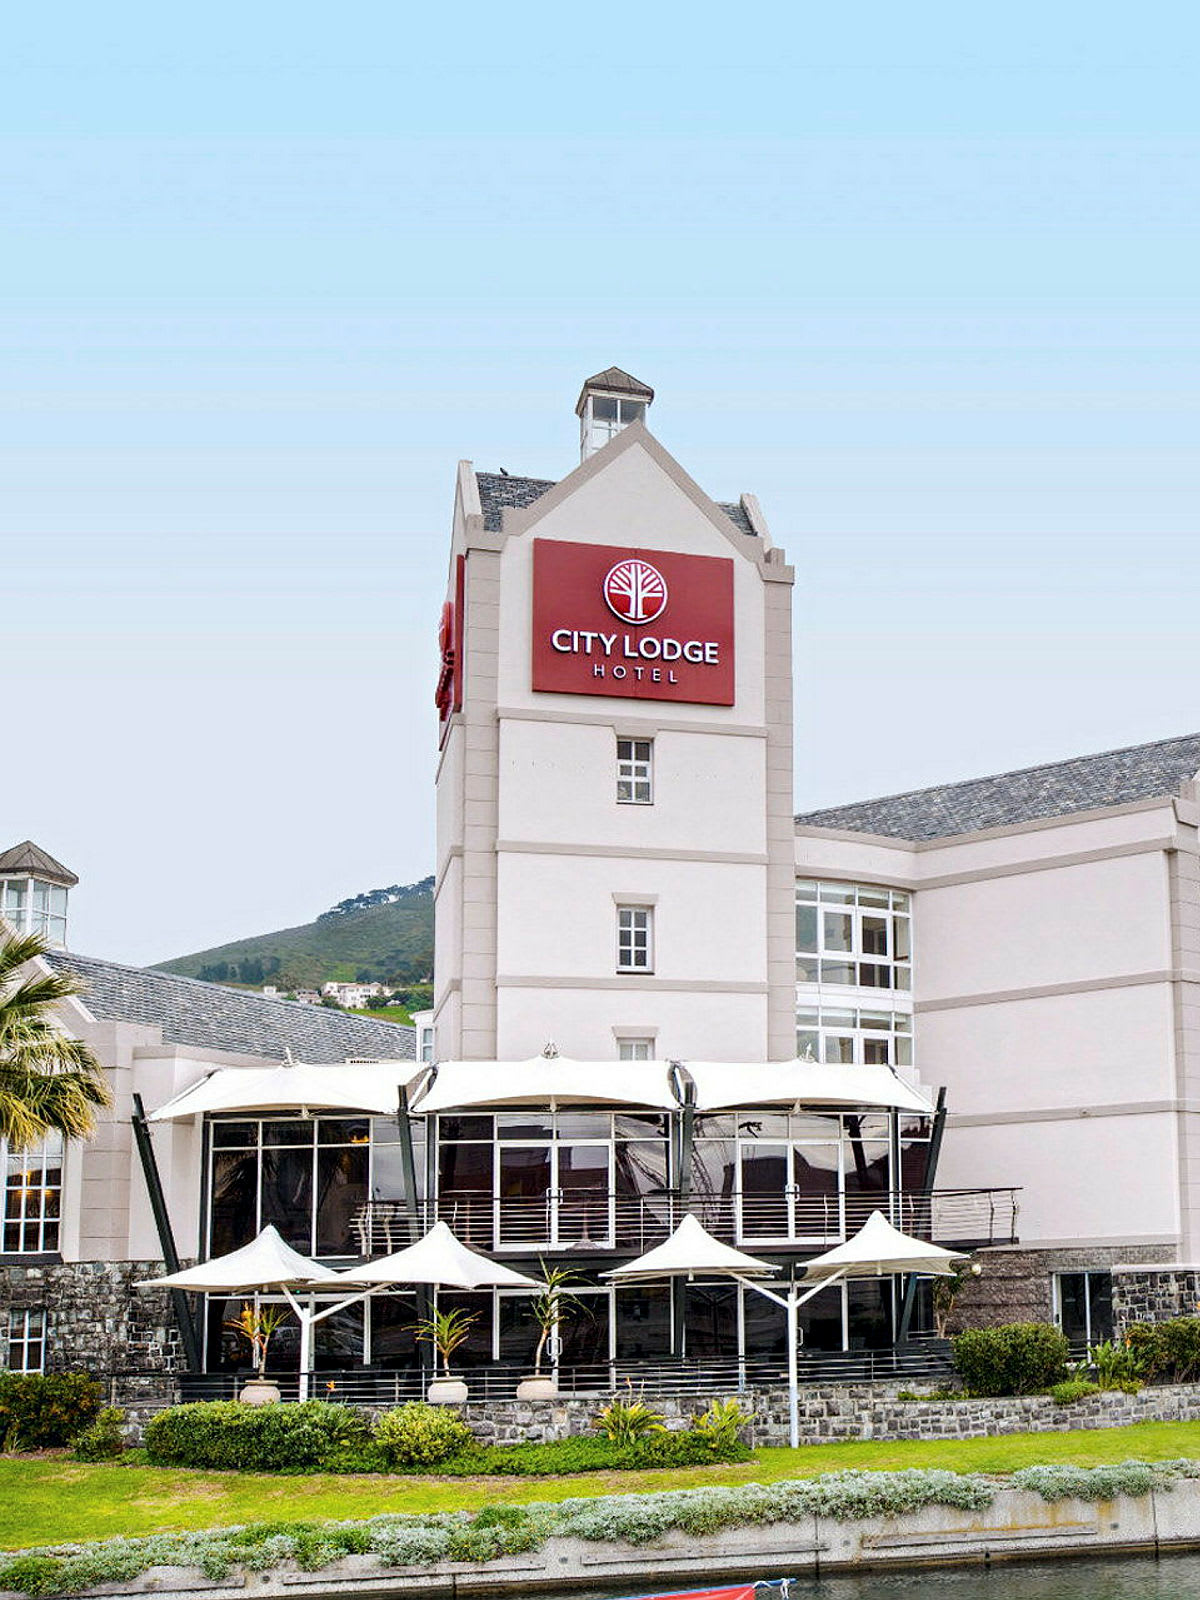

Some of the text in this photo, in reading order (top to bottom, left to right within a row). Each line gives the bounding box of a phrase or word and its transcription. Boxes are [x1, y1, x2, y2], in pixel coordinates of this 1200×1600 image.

[551, 629, 720, 664] CITY LODGE
[593, 664, 678, 683] HOTEL
